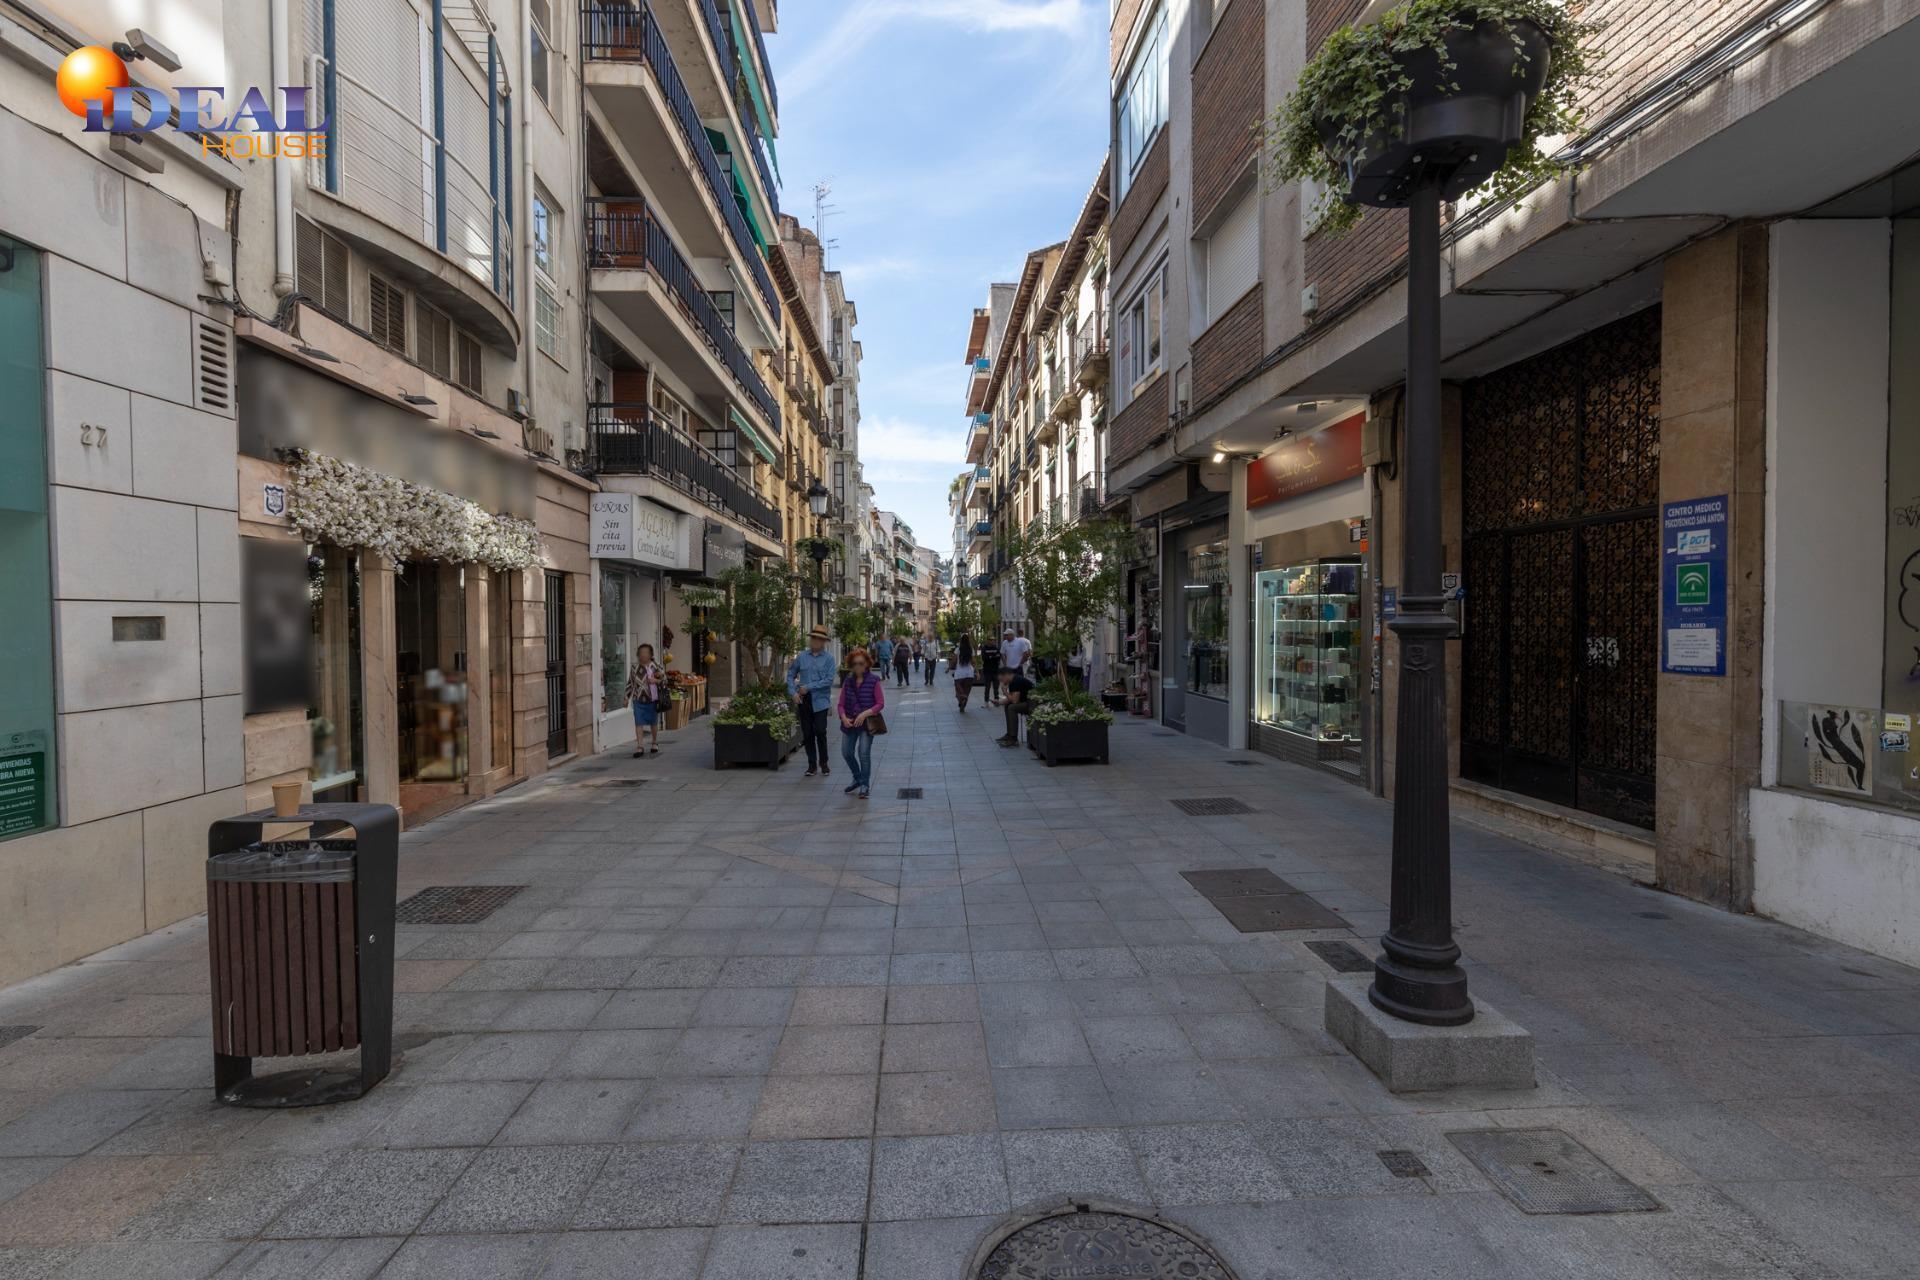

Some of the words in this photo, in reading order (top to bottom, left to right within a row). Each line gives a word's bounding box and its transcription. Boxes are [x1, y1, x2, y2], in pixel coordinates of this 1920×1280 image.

[80, 422, 107, 448] 27
[592, 501, 630, 514] UÑAS
[1668, 506, 1692, 517] CENTRO
[1694, 501, 1722, 514] MEDICO
[602, 519, 620, 530] Sin
[1696, 514, 1707, 525] SAN
[602, 530, 621, 541] cita
[1690, 535, 1709, 545] DGT
[595, 541, 627, 554] previa
[0, 770, 15, 780] BRA
[1049, 1262, 1155, 1278] emasagra
